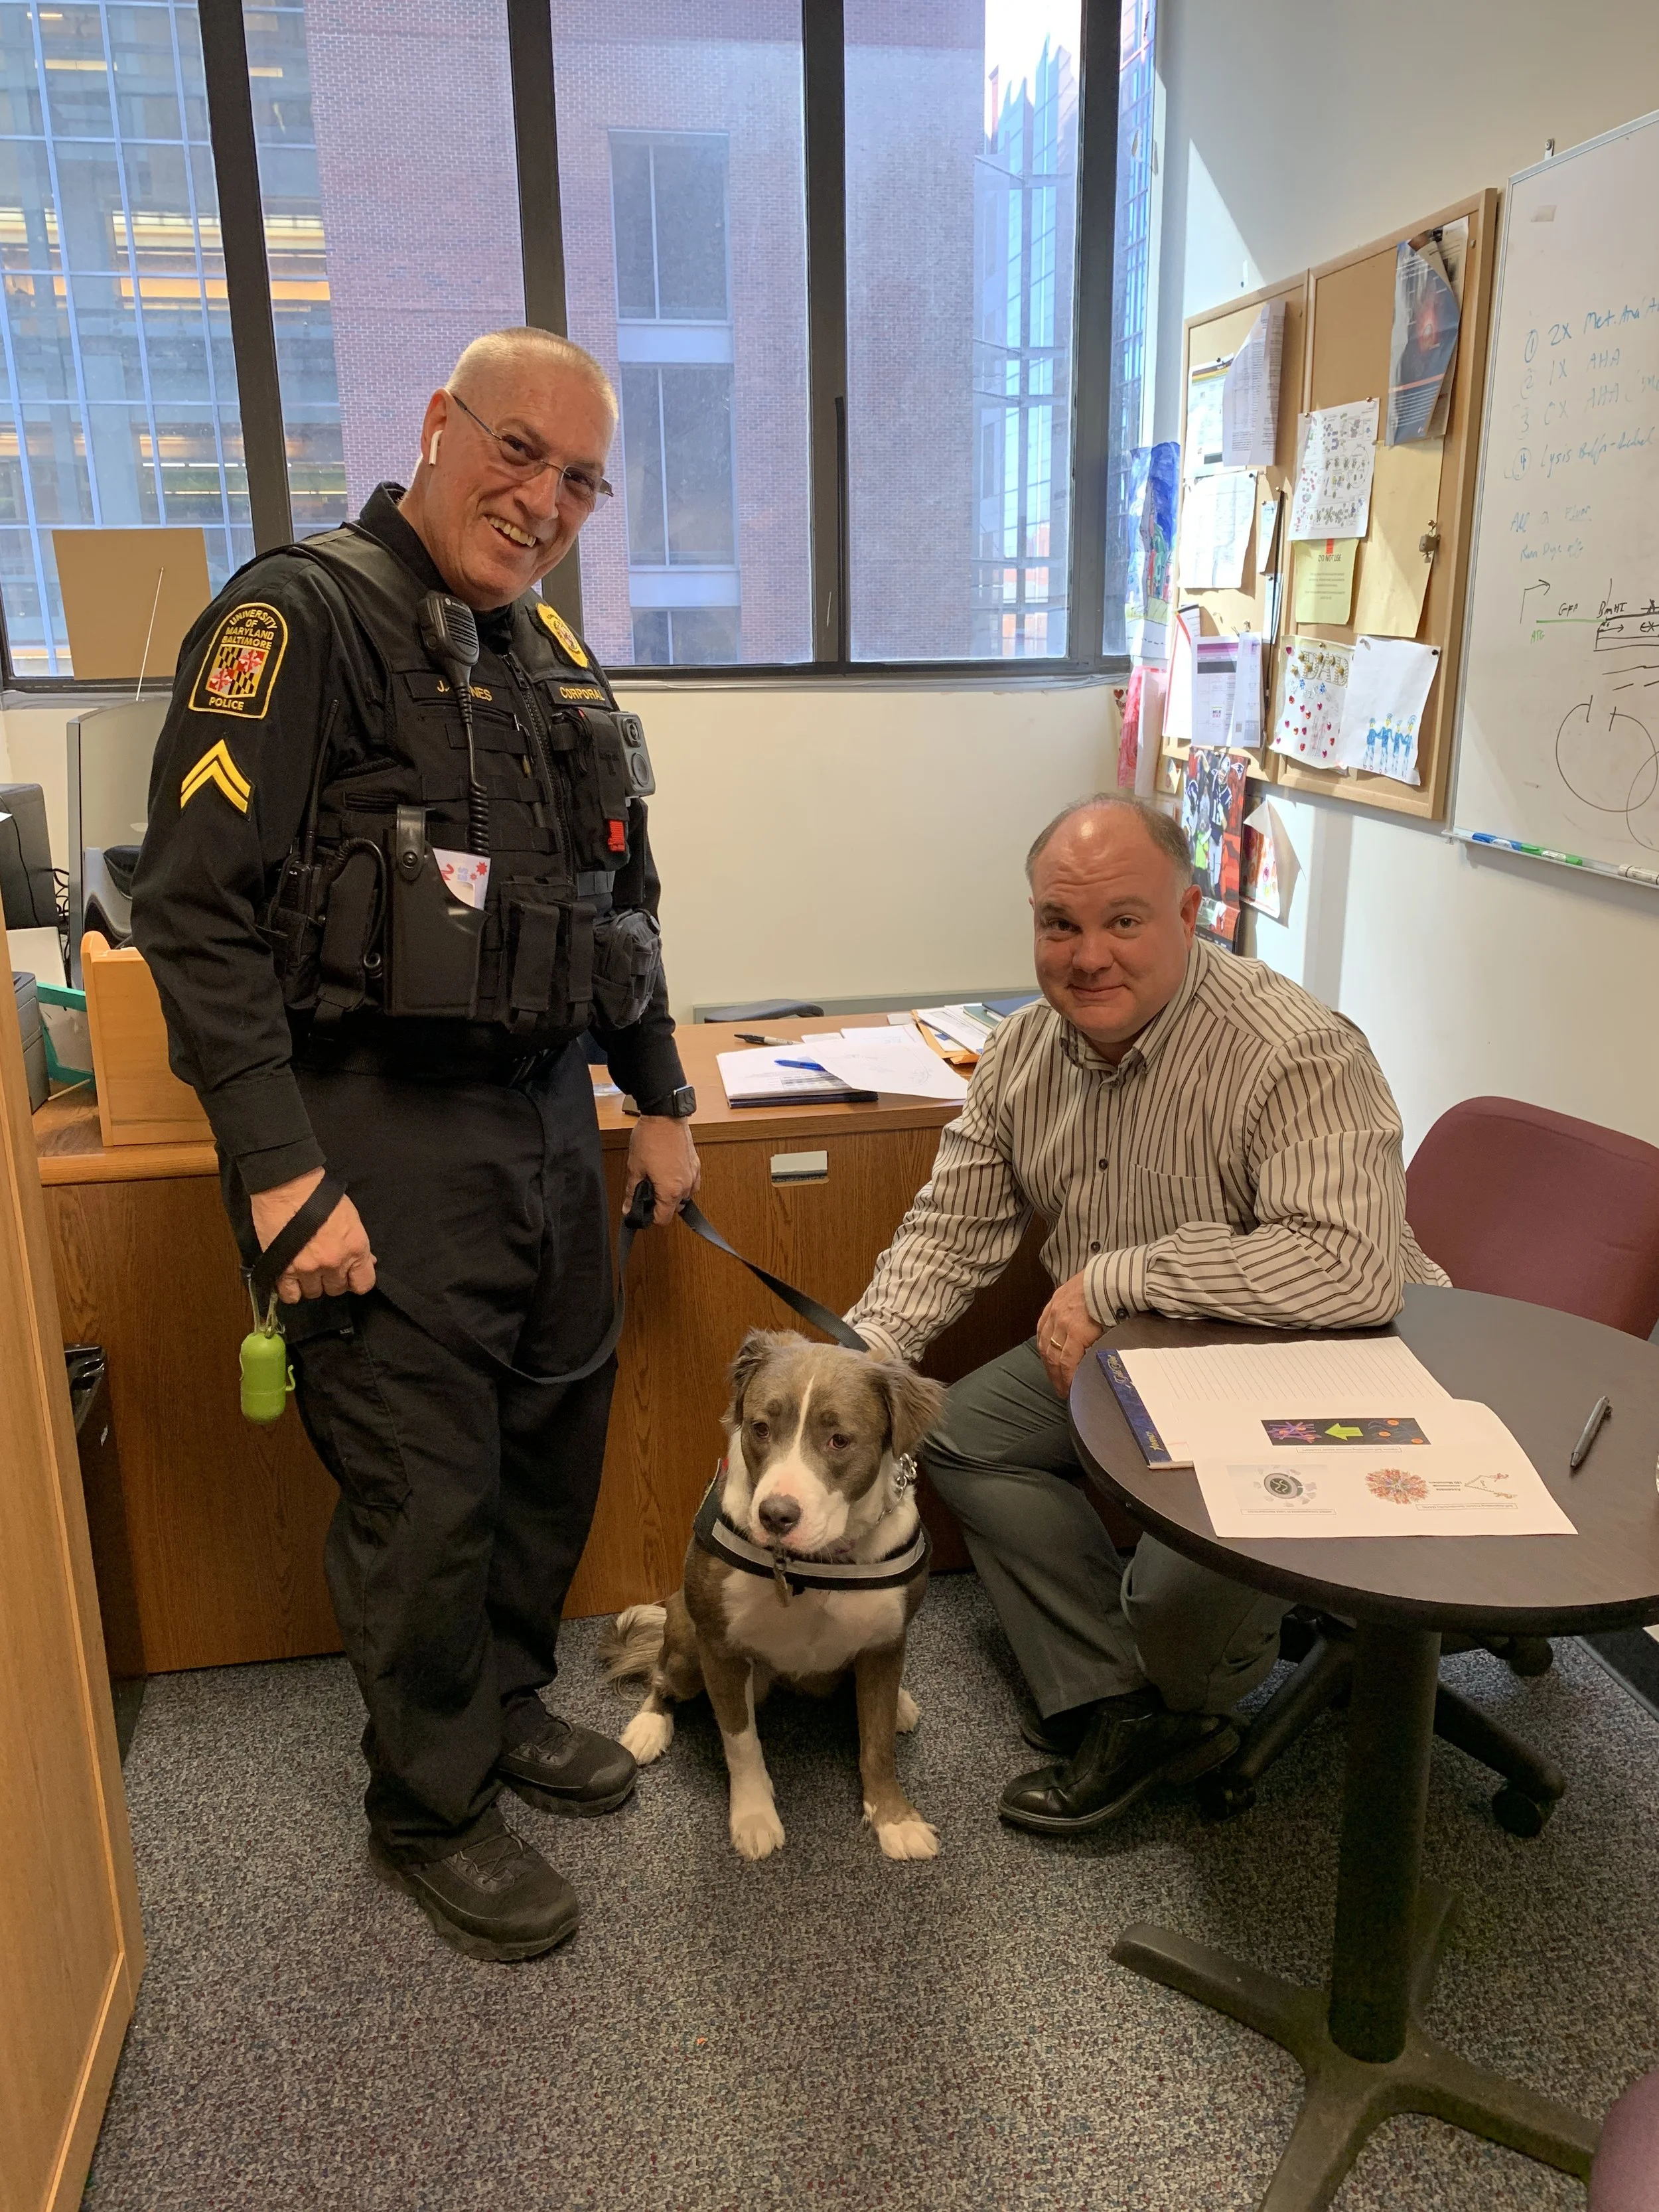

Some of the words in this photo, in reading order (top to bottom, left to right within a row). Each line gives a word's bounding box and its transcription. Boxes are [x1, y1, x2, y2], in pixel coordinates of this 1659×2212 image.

[229, 609, 278, 630] UNIVERSITY
[245, 619, 259, 628] OF
[225, 627, 275, 641] MARYLAND
[221, 635, 273, 650] BALTIMORE
[1301, 650, 1350, 686] DAD
[559, 686, 606, 701] CORPORAL
[208, 696, 245, 711] POLICE
